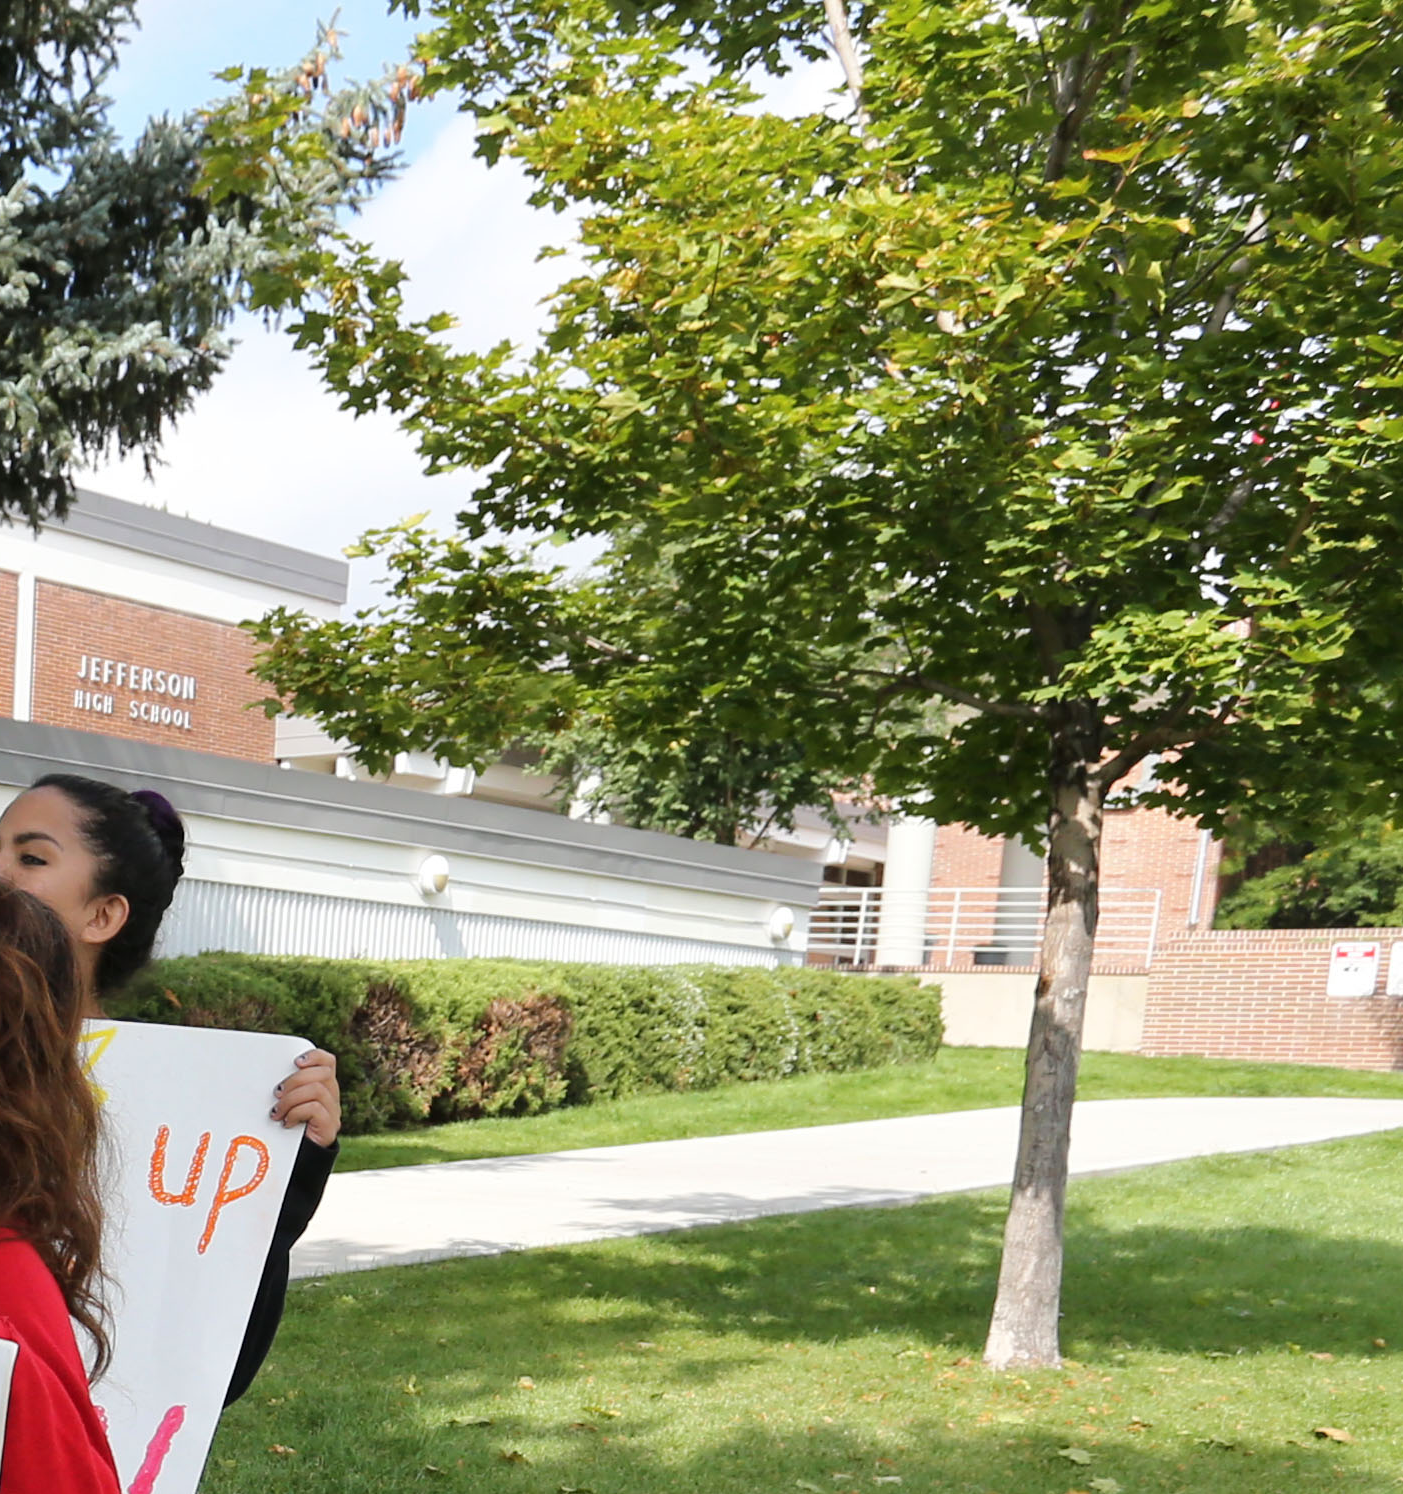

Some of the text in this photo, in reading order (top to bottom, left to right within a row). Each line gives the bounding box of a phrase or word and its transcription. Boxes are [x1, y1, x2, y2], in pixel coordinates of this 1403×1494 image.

[77, 655, 197, 700] JEFFERSON
[73, 689, 193, 730] HIGH SCHOOL
